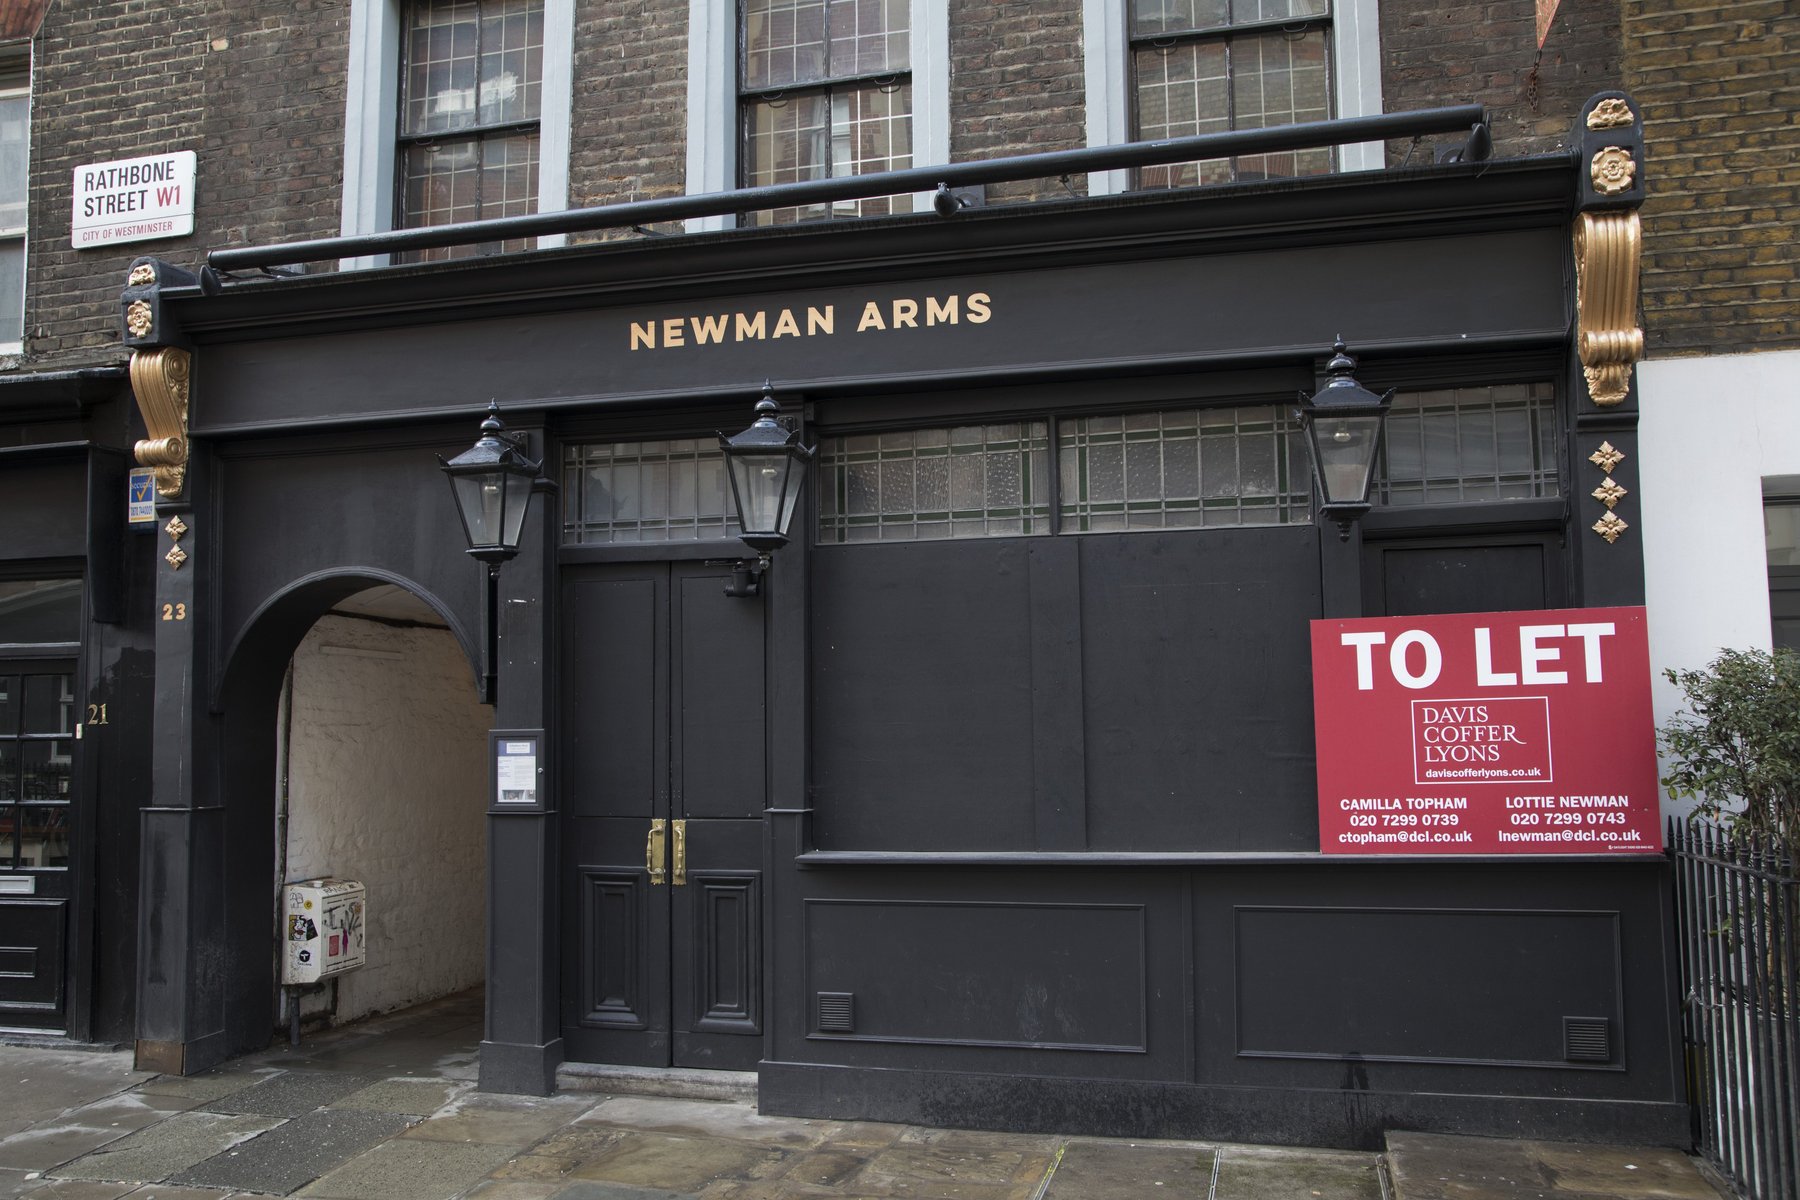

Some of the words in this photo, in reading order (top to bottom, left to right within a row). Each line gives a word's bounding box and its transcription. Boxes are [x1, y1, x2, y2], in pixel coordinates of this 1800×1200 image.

[84, 160, 175, 192] RATHBONE
[84, 189, 149, 218] STREET
[156, 184, 181, 208] W1
[82, 230, 100, 242] CITY
[102, 228, 113, 239] OF
[114, 221, 173, 237] WESTMINSTER
[630, 305, 834, 350] NEWMAN
[856, 292, 992, 332] ARMS
[162, 603, 186, 621] 23
[1341, 629, 1442, 690] TO
[1474, 622, 1616, 687] LET
[88, 703, 109, 725] 21
[1422, 705, 1489, 724] DAVIS
[1423, 725, 1527, 745] COFFER
[1424, 744, 1500, 763] LYONS
[1425, 767, 1542, 779] daviscofferlyons.co.uk
[1340, 798, 1403, 810] CAMILLA
[1406, 797, 1467, 810] TOPHAM
[1505, 796, 1556, 809] LOTTIE
[1559, 795, 1629, 808] NEWMAN
[1350, 814, 1377, 827] 020
[1381, 814, 1418, 826] 7299
[1422, 813, 1459, 826] 0739
[1510, 813, 1540, 825] 020
[1544, 813, 1583, 825] 7299
[1586, 812, 1626, 825] 0743
[1338, 831, 1473, 845] ctopham@dcl.co.uk
[1498, 829, 1641, 842] lnewman@dcl.co.uk
